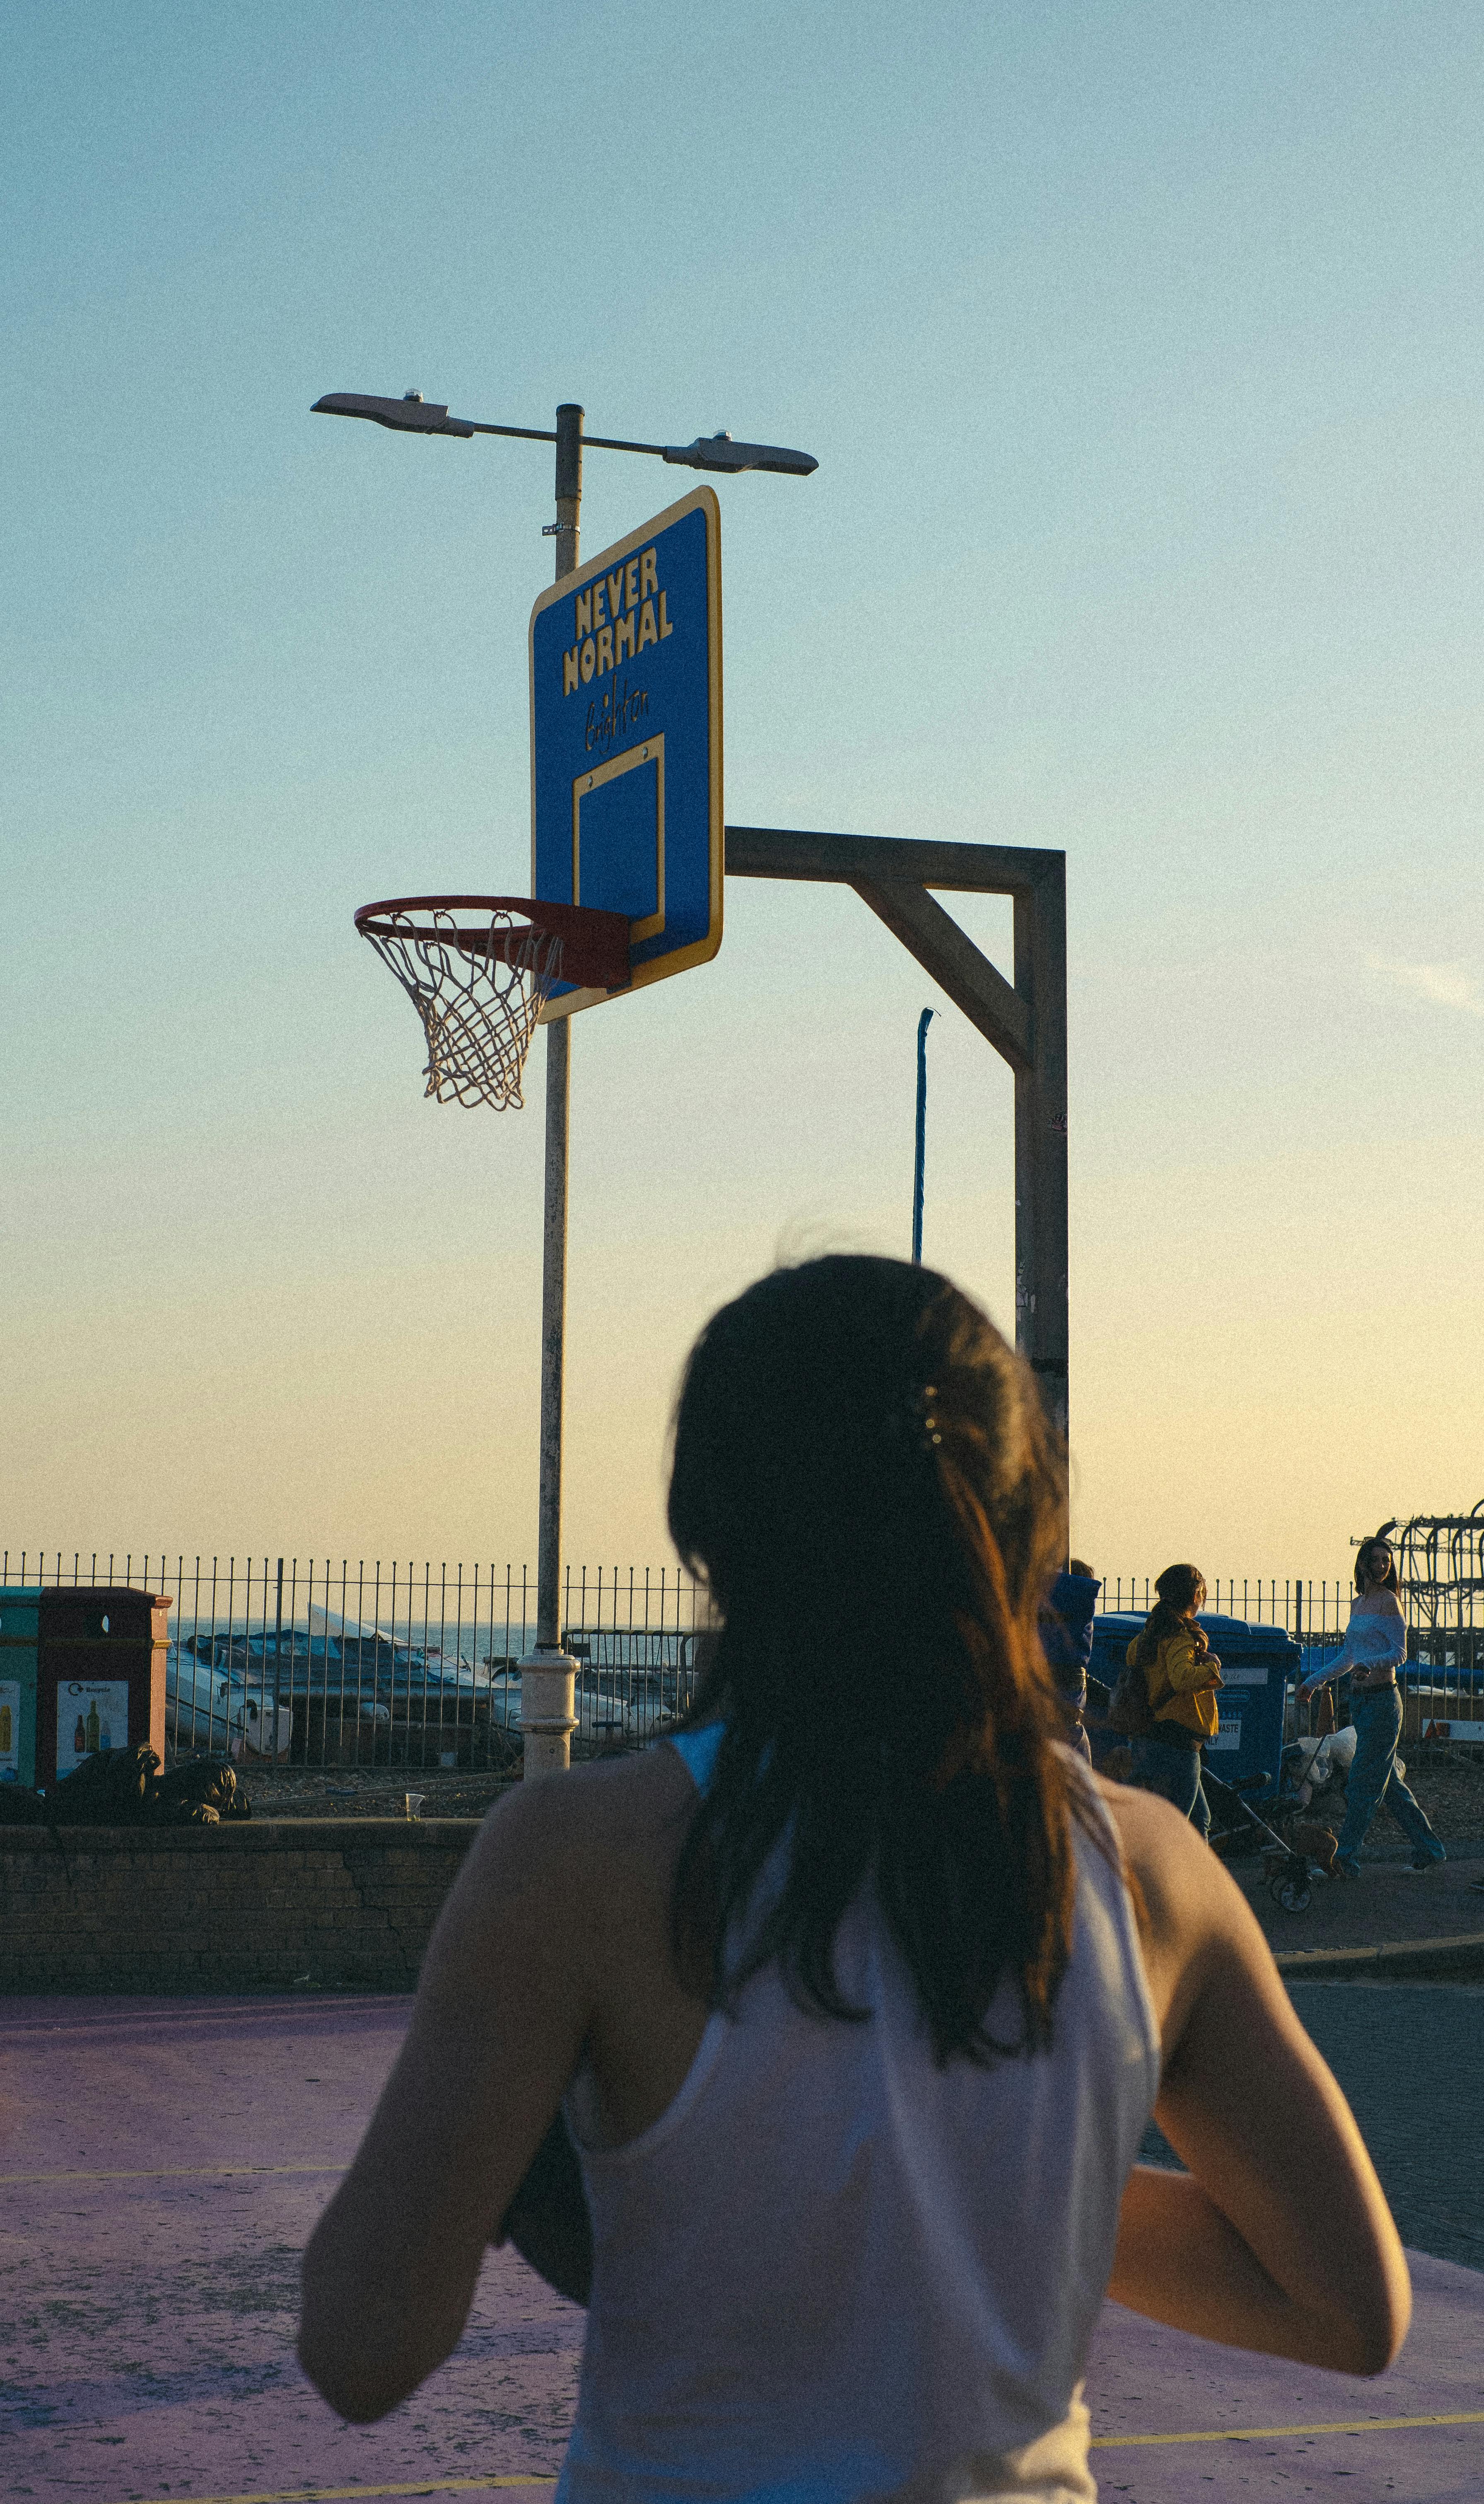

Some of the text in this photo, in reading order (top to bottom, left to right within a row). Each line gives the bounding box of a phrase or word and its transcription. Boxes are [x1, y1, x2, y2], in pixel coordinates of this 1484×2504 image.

[575, 546, 658, 641] NEVER
[563, 590, 673, 697] NORMAL
[1206, 1736, 1219, 1745] NLY
